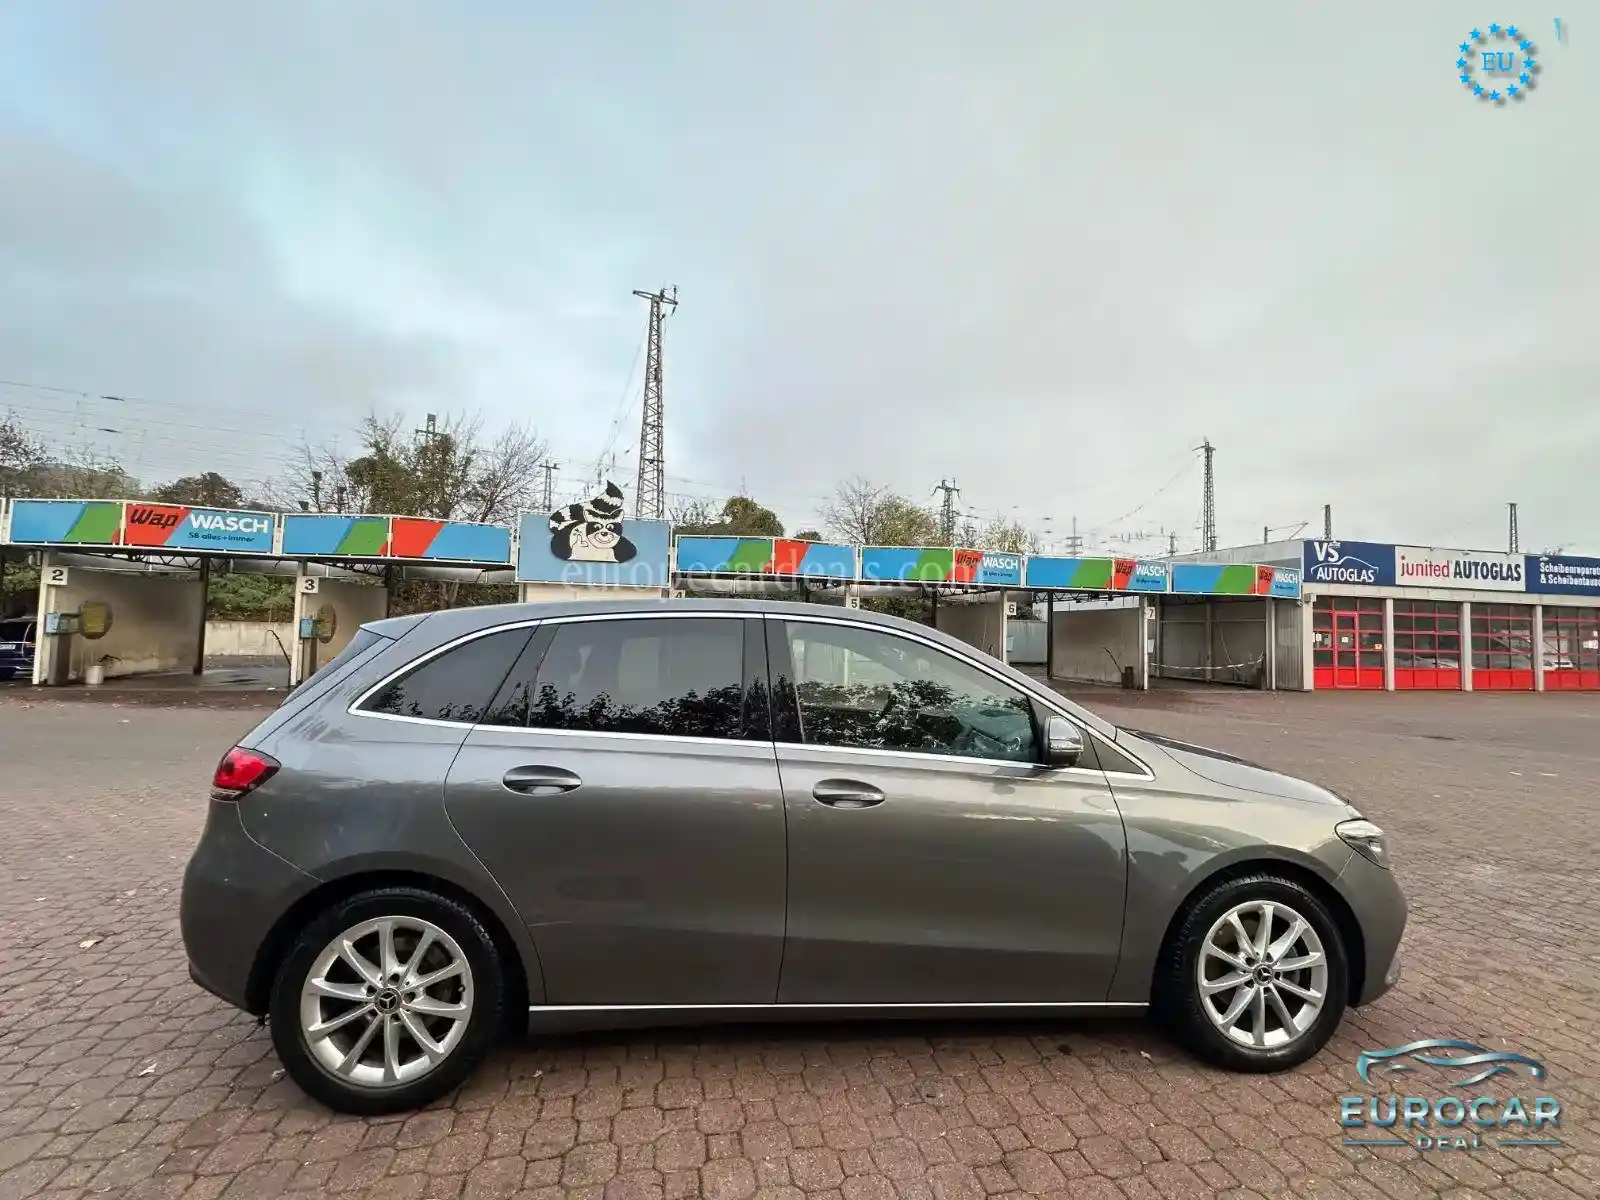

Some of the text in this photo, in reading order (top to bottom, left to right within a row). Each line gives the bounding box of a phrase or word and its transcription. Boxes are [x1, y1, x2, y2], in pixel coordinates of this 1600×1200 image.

[130, 508, 269, 533] Wap WASCH
[1313, 541, 1340, 562] VS
[957, 553, 1019, 570] Wap WASCH
[52, 569, 64, 581] 2
[1115, 561, 1165, 577] Wap WASCH
[1316, 567, 1375, 583] AUTOGLAS
[1400, 555, 1522, 582] junited AUTOGLAS
[1274, 571, 1298, 584] WASCH
[1540, 573, 1547, 584] &
[304, 578, 315, 591] 3
[851, 598, 858, 608] 5
[1008, 604, 1015, 613] 6
[1149, 608, 1154, 618] 7
